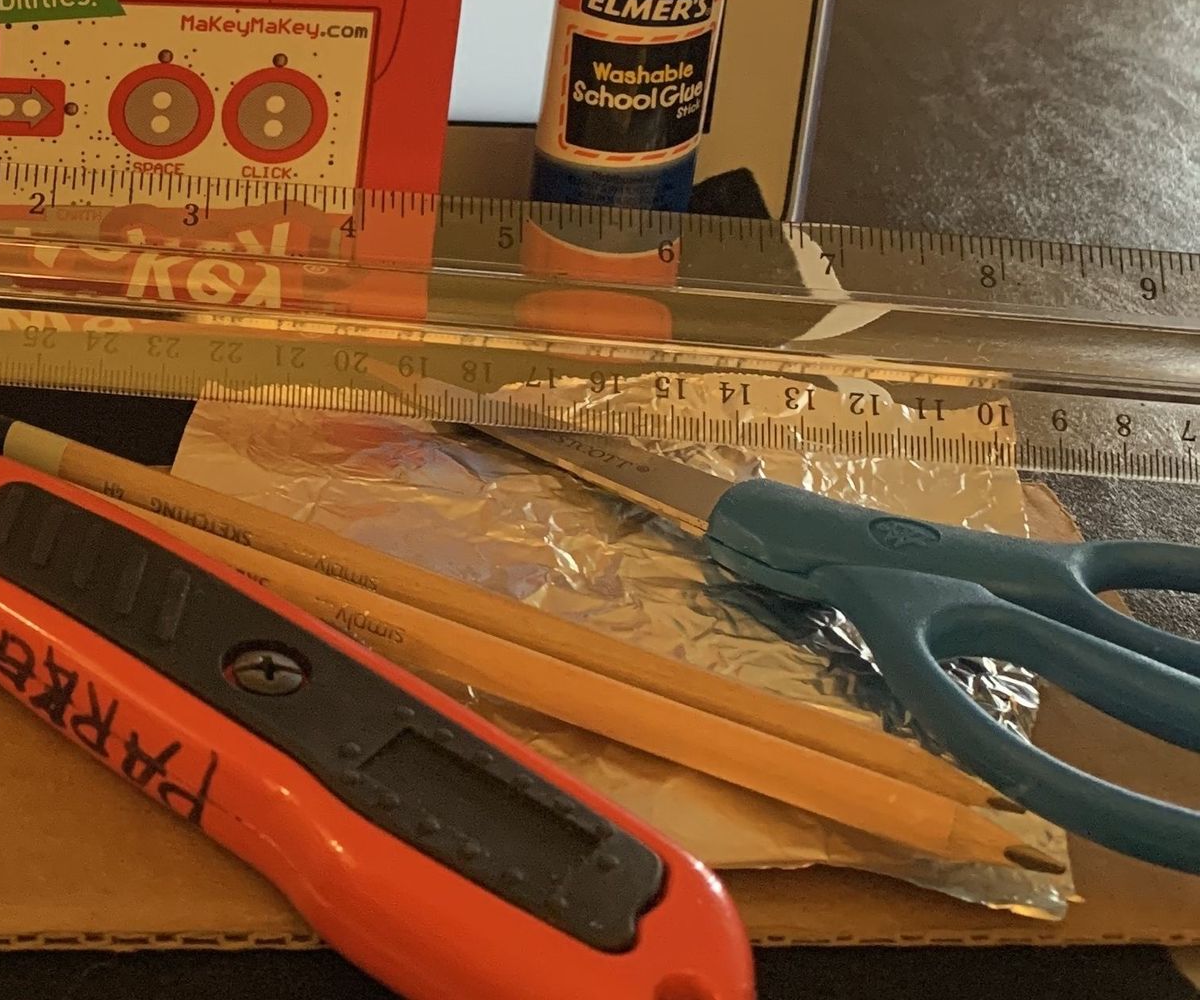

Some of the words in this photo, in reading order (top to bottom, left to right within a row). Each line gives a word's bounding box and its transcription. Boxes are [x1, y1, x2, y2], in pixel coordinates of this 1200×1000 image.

[181, 15, 369, 39] MaKeyMaKey.com
[592, 61, 694, 85] Washable
[573, 79, 657, 111] School
[660, 81, 703, 108] Glue
[133, 162, 184, 176] SPACE
[242, 165, 292, 179] CLICK
[29, 192, 46, 215] 2
[183, 203, 200, 226] 3
[340, 216, 357, 239] 4
[498, 226, 515, 250] 5
[657, 240, 676, 264] 6
[819, 252, 836, 276] 7
[979, 264, 997, 288] 8
[1140, 277, 1157, 301] 9
[552, 433, 634, 470] STCOTT
[150, 496, 253, 548] SKETCHING
